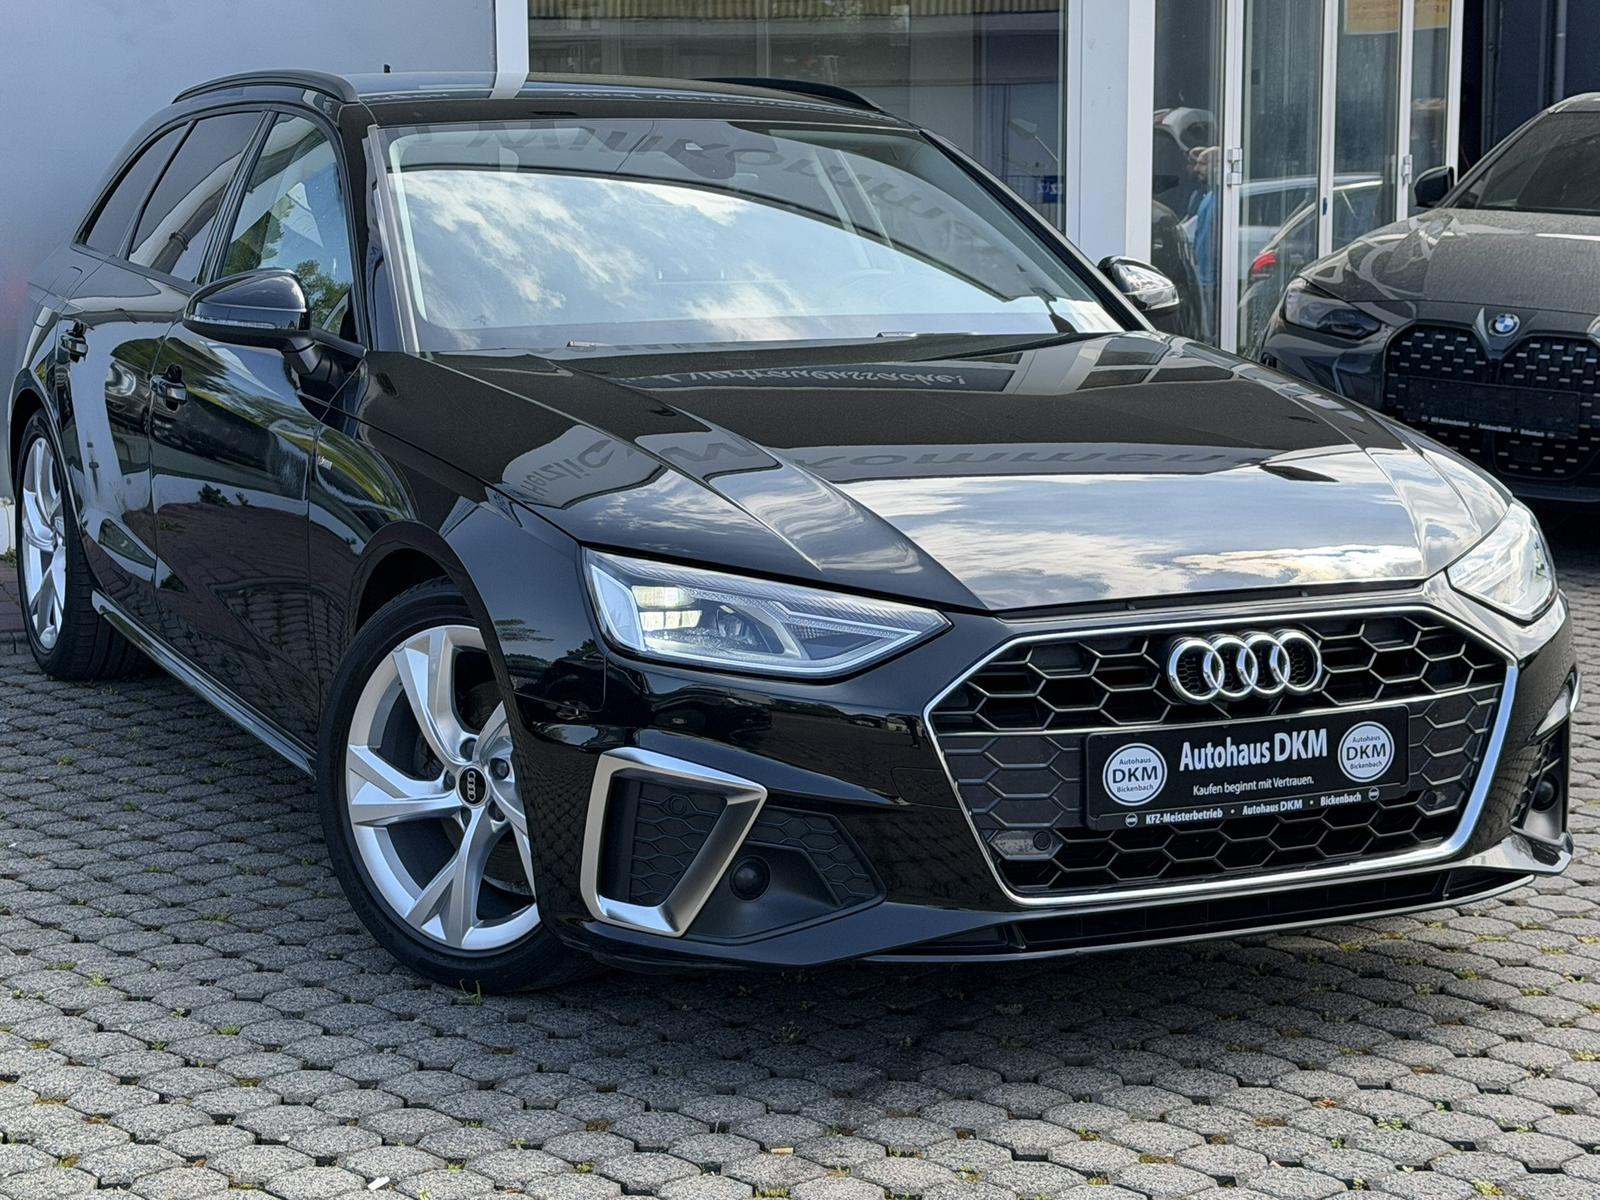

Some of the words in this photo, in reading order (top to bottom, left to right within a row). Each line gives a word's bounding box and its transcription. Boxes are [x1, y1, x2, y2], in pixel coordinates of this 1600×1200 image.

[1351, 735, 1381, 743] Autohaus
[1178, 736, 1271, 771] Autohaus
[1273, 728, 1328, 762] DKM
[1346, 742, 1386, 761] DKM
[1119, 757, 1152, 765] Autohaus
[1350, 760, 1383, 770] Bickenbach
[1112, 765, 1158, 784] DKM
[1116, 784, 1153, 793] Bickenbach
[1192, 782, 1223, 796] Kaufen
[1224, 780, 1257, 794] beginnt
[1257, 778, 1273, 790] mit
[1272, 775, 1315, 788] Vertrauen.
[1145, 808, 1223, 825] KFZ-Meisterbetrieb
[1242, 803, 1280, 816] Autohaus
[1279, 799, 1303, 811] DKM
[1320, 791, 1362, 807] Bickenbach
